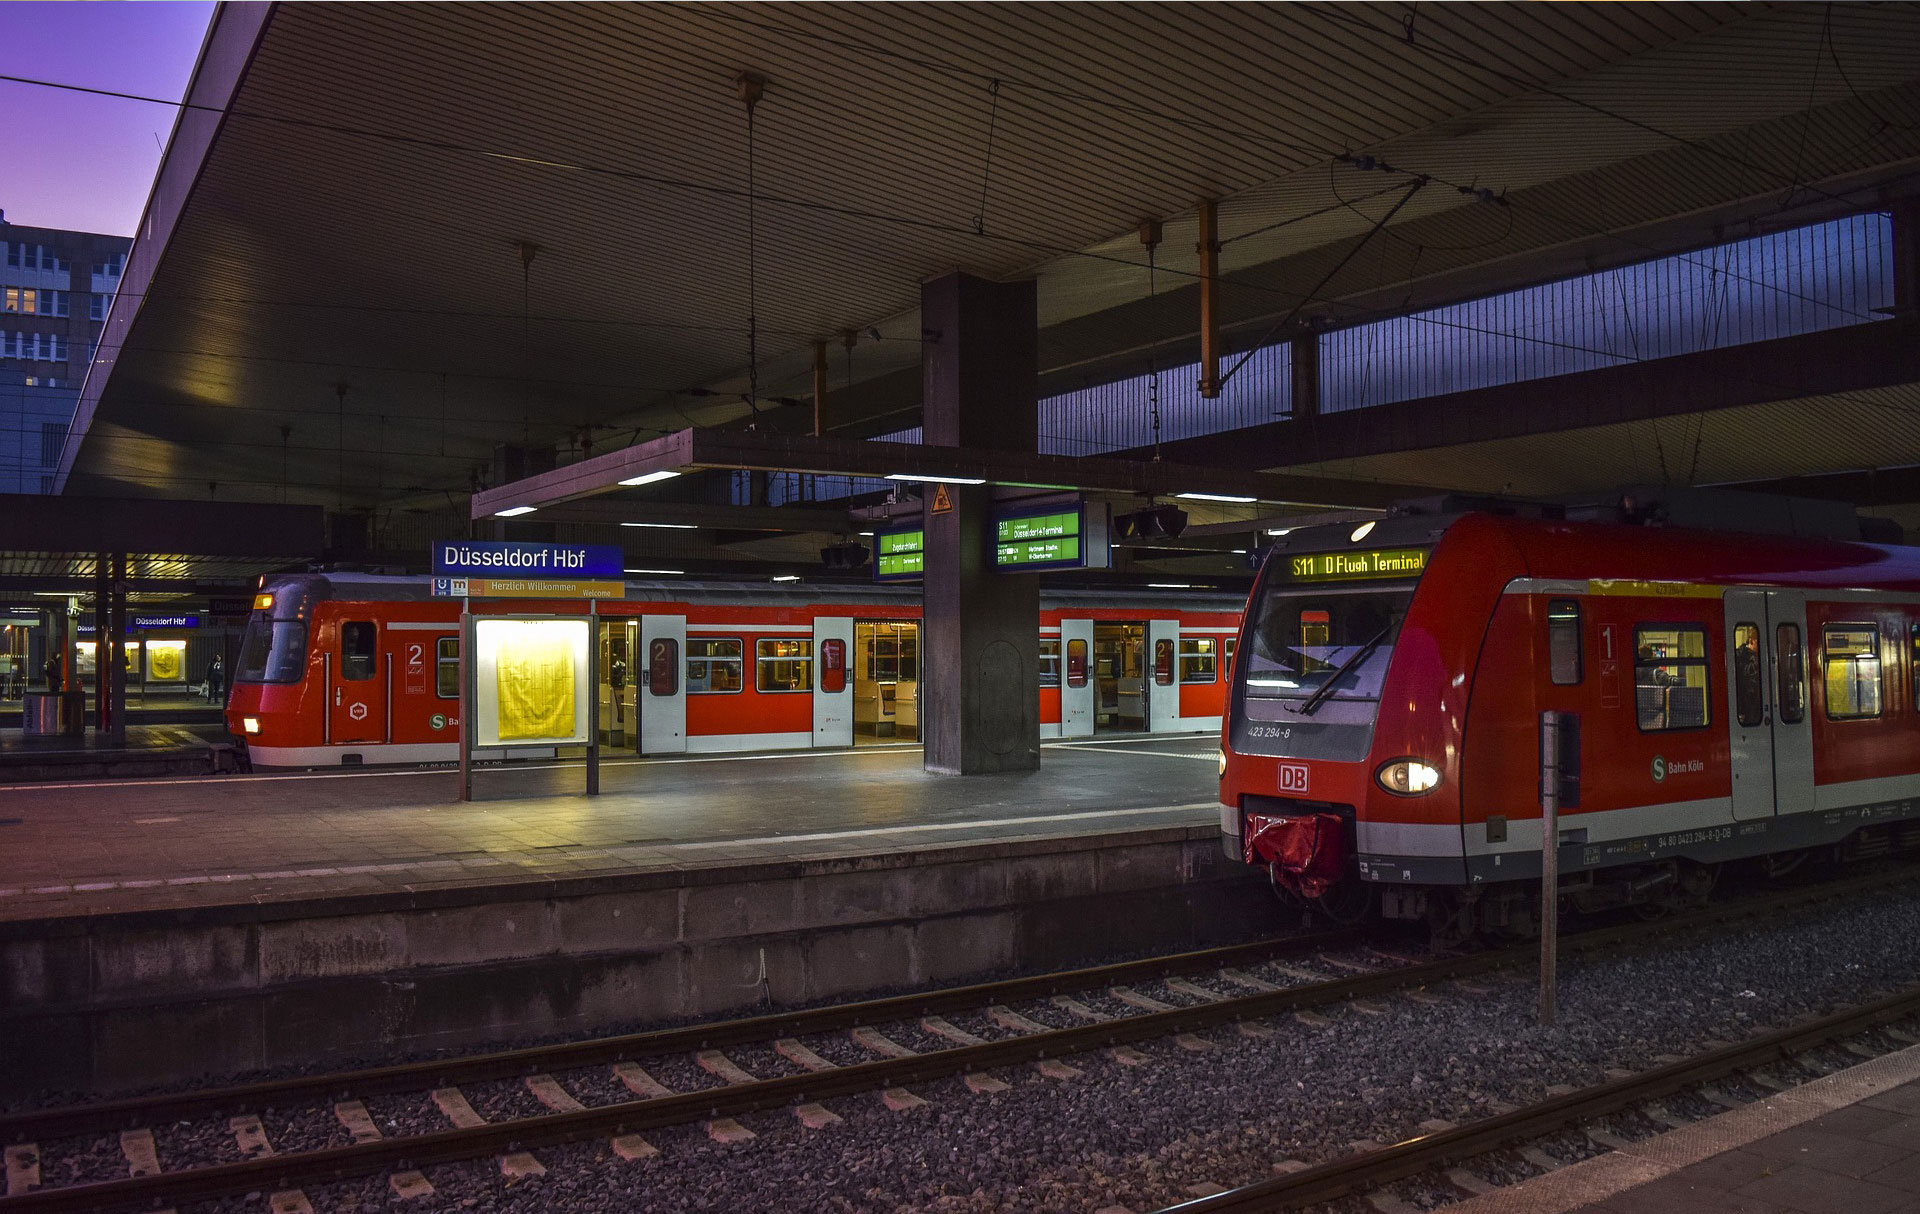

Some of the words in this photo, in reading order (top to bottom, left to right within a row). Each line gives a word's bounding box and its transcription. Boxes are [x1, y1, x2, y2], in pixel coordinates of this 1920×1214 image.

[444, 546, 548, 568] Düsseldorf
[553, 549, 586, 569] Hbf
[1293, 557, 1314, 576] S11
[1325, 556, 1333, 574] D
[1336, 555, 1368, 574] Flugh
[1372, 552, 1425, 572] Terminal
[491, 581, 525, 591] Herzlich
[527, 582, 577, 592] Willkommen
[582, 589, 611, 597] Welcome
[135, 617, 172, 626] Düsseldorf
[173, 618, 186, 626] Hbf
[1157, 642, 1165, 658] 2
[1602, 626, 1611, 659] 1
[409, 645, 422, 665] 2
[654, 643, 665, 661] 2
[1248, 726, 1264, 737] 423
[1265, 727, 1291, 739] 294-8
[1668, 761, 1687, 775] Bahn
[1687, 759, 1704, 773] Köln
[1282, 767, 1306, 789] DB
